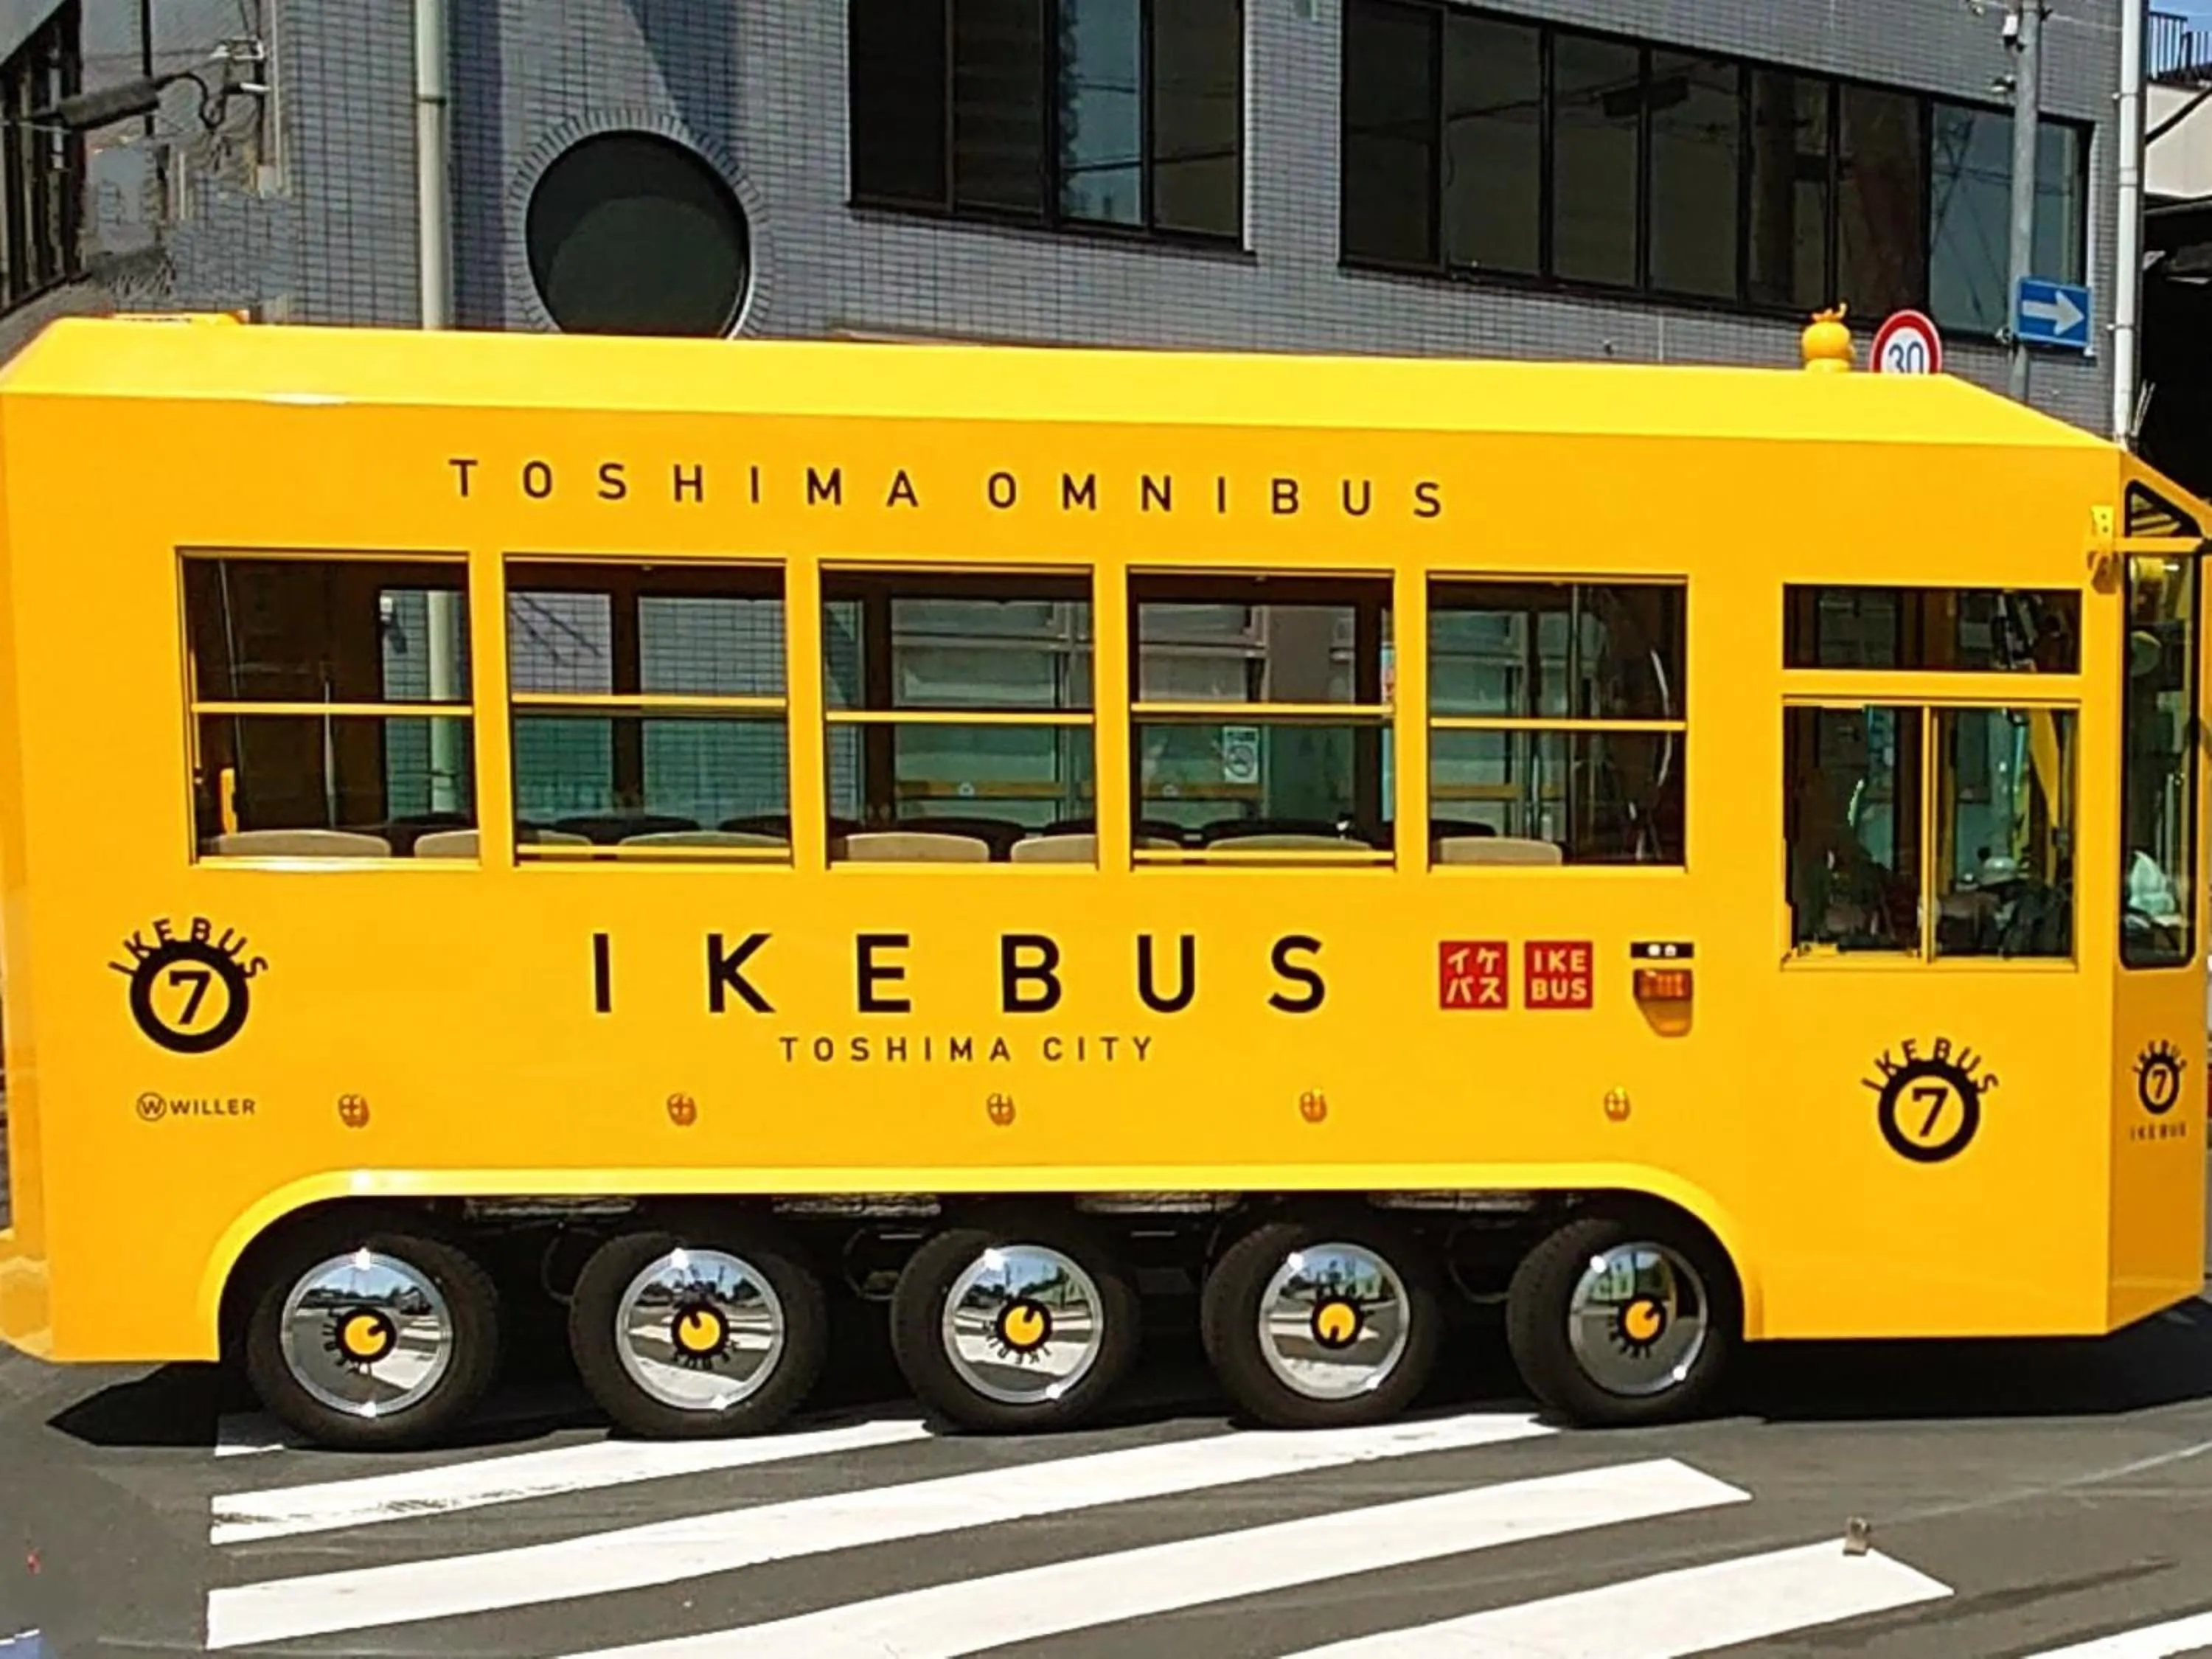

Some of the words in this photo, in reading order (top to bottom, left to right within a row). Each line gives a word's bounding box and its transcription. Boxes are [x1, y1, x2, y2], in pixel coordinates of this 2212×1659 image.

[1888, 341, 1924, 374] 30
[449, 459, 918, 507] TOSHIMA
[988, 472, 1441, 518] OMNIBUS
[109, 917, 268, 979] IKEBUS
[1447, 947, 1500, 974] イケ
[1534, 949, 1587, 973] IKE
[593, 933, 1325, 1014] IKEBUS
[1531, 977, 1587, 1001] BUS
[169, 970, 211, 1025] 7
[1446, 977, 1502, 1004] バス
[779, 1037, 1010, 1062] TOSHIMA
[1043, 1037, 1152, 1062] CITY
[1860, 1037, 1999, 1094] IKEBUS
[2152, 1068, 2168, 1100] 7
[170, 1099, 256, 1116] WILLER
[1912, 1087, 1949, 1137] 7
